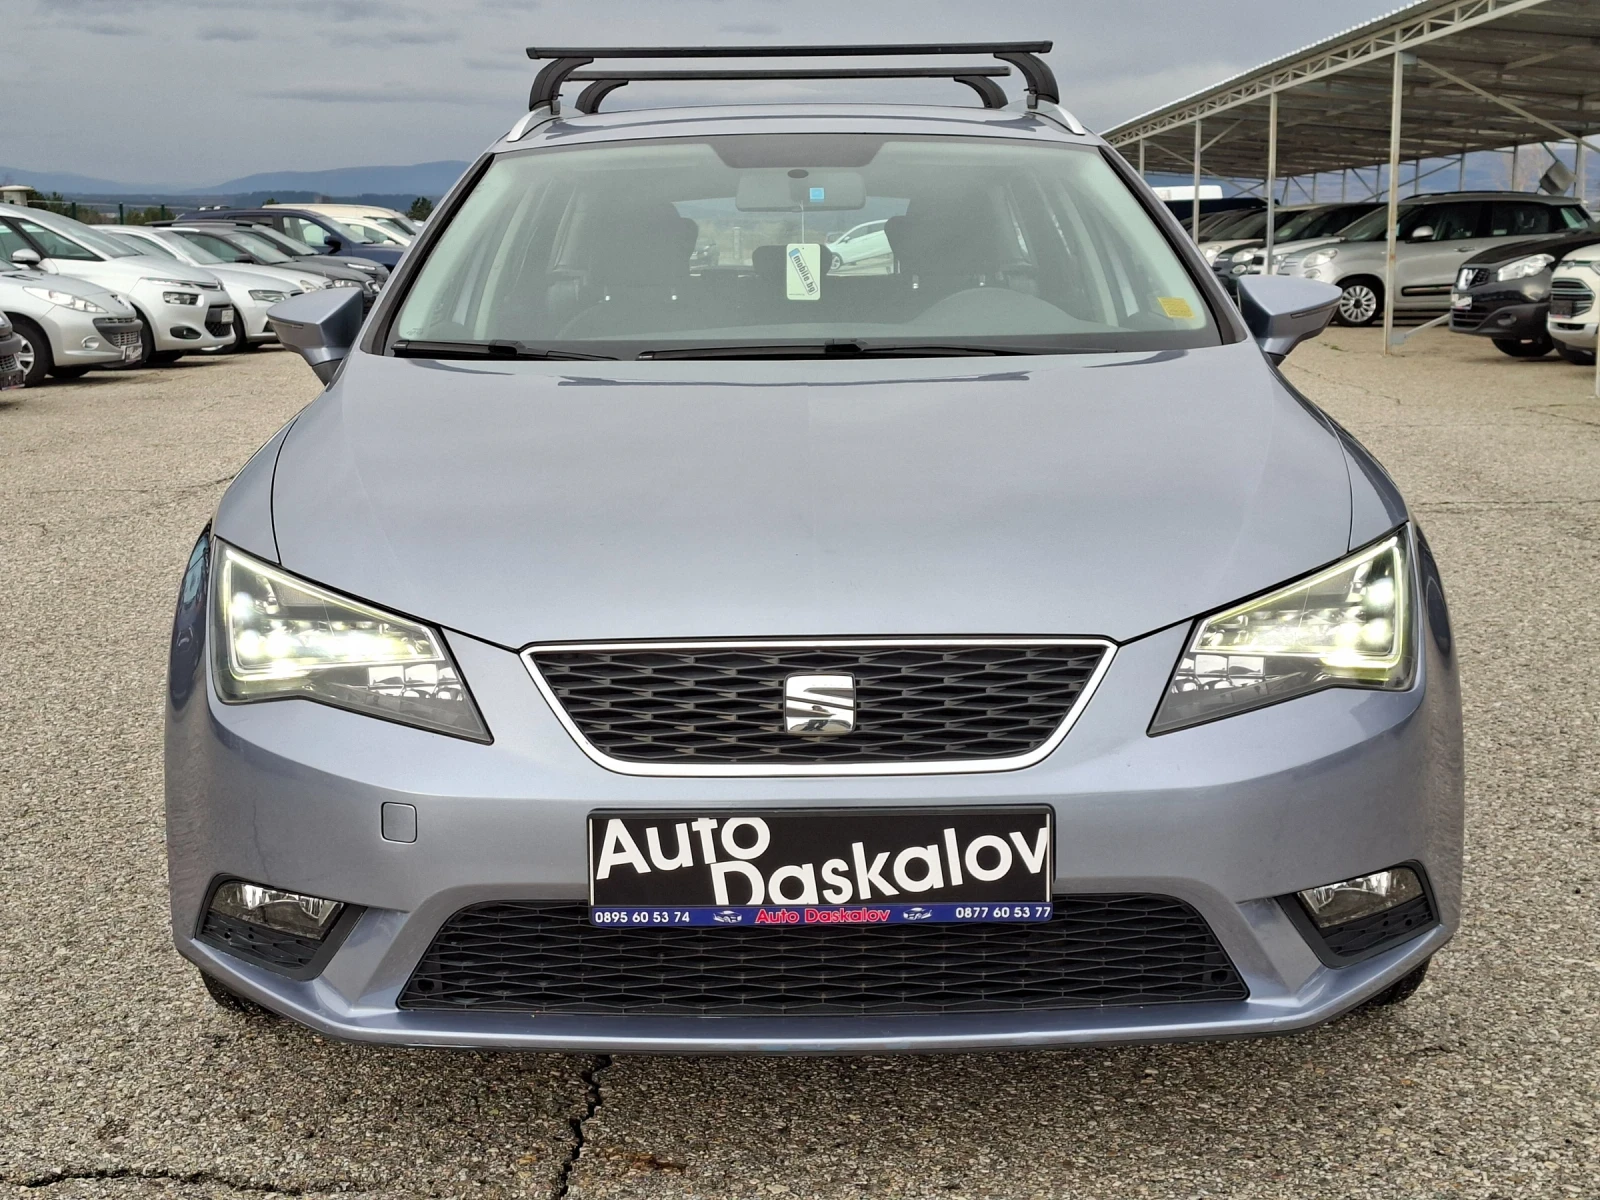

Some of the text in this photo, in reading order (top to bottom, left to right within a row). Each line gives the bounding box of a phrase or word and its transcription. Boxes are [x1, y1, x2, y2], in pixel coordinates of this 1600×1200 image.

[793, 255, 816, 293] mobile.bg
[596, 817, 771, 880] Auto
[710, 827, 1048, 906] Daskalov
[595, 911, 690, 923] 0895 60 53 74
[754, 907, 891, 924] Auto Daskalov
[955, 906, 1051, 919] 0877 60 53 77
